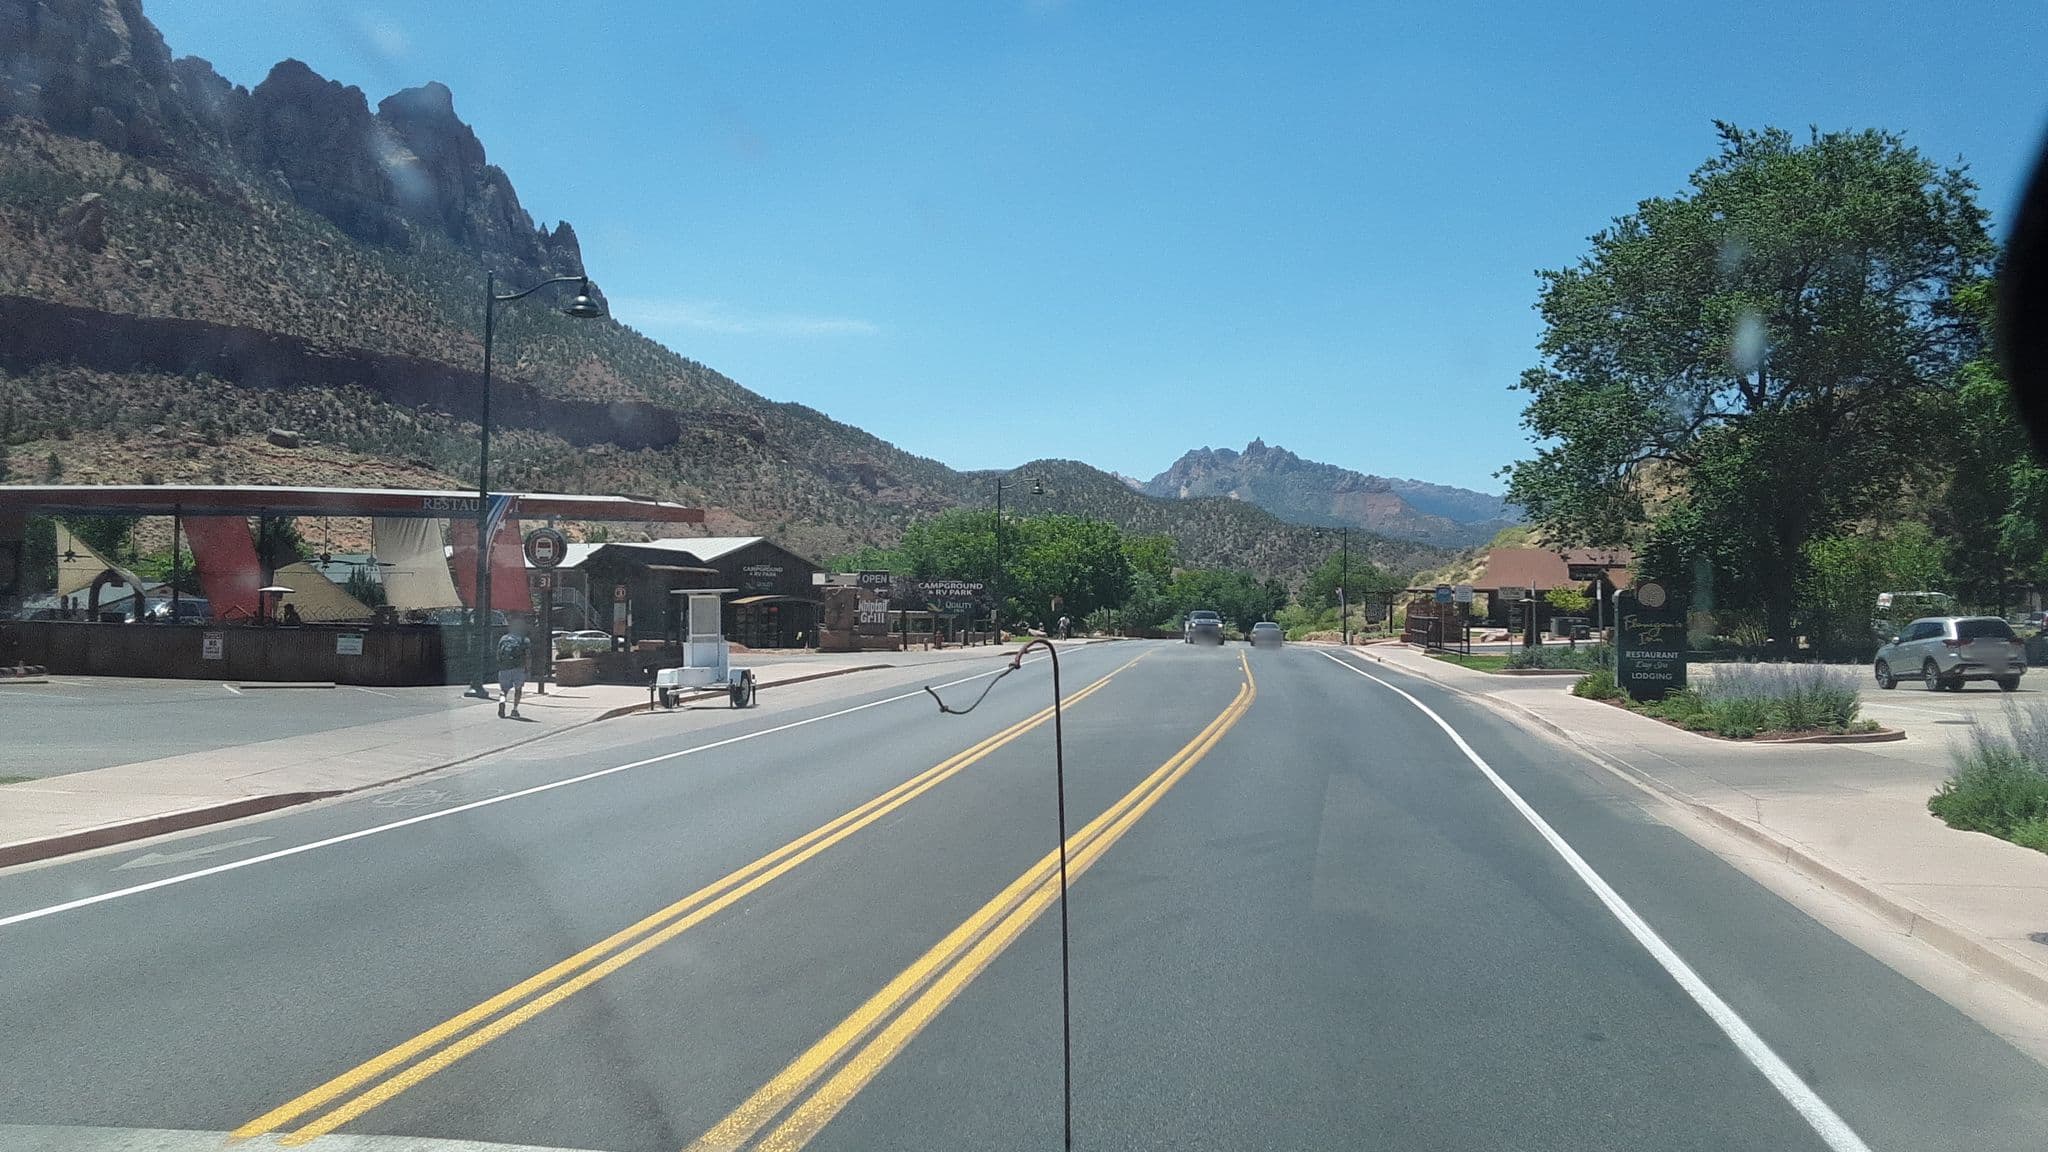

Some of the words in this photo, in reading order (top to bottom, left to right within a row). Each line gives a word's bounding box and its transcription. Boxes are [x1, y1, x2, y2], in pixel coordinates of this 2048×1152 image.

[862, 574, 888, 584] OPEN
[860, 612, 885, 623] Grill
[1625, 650, 1679, 659] RESTAURANT
[1631, 672, 1673, 680] LODGING
